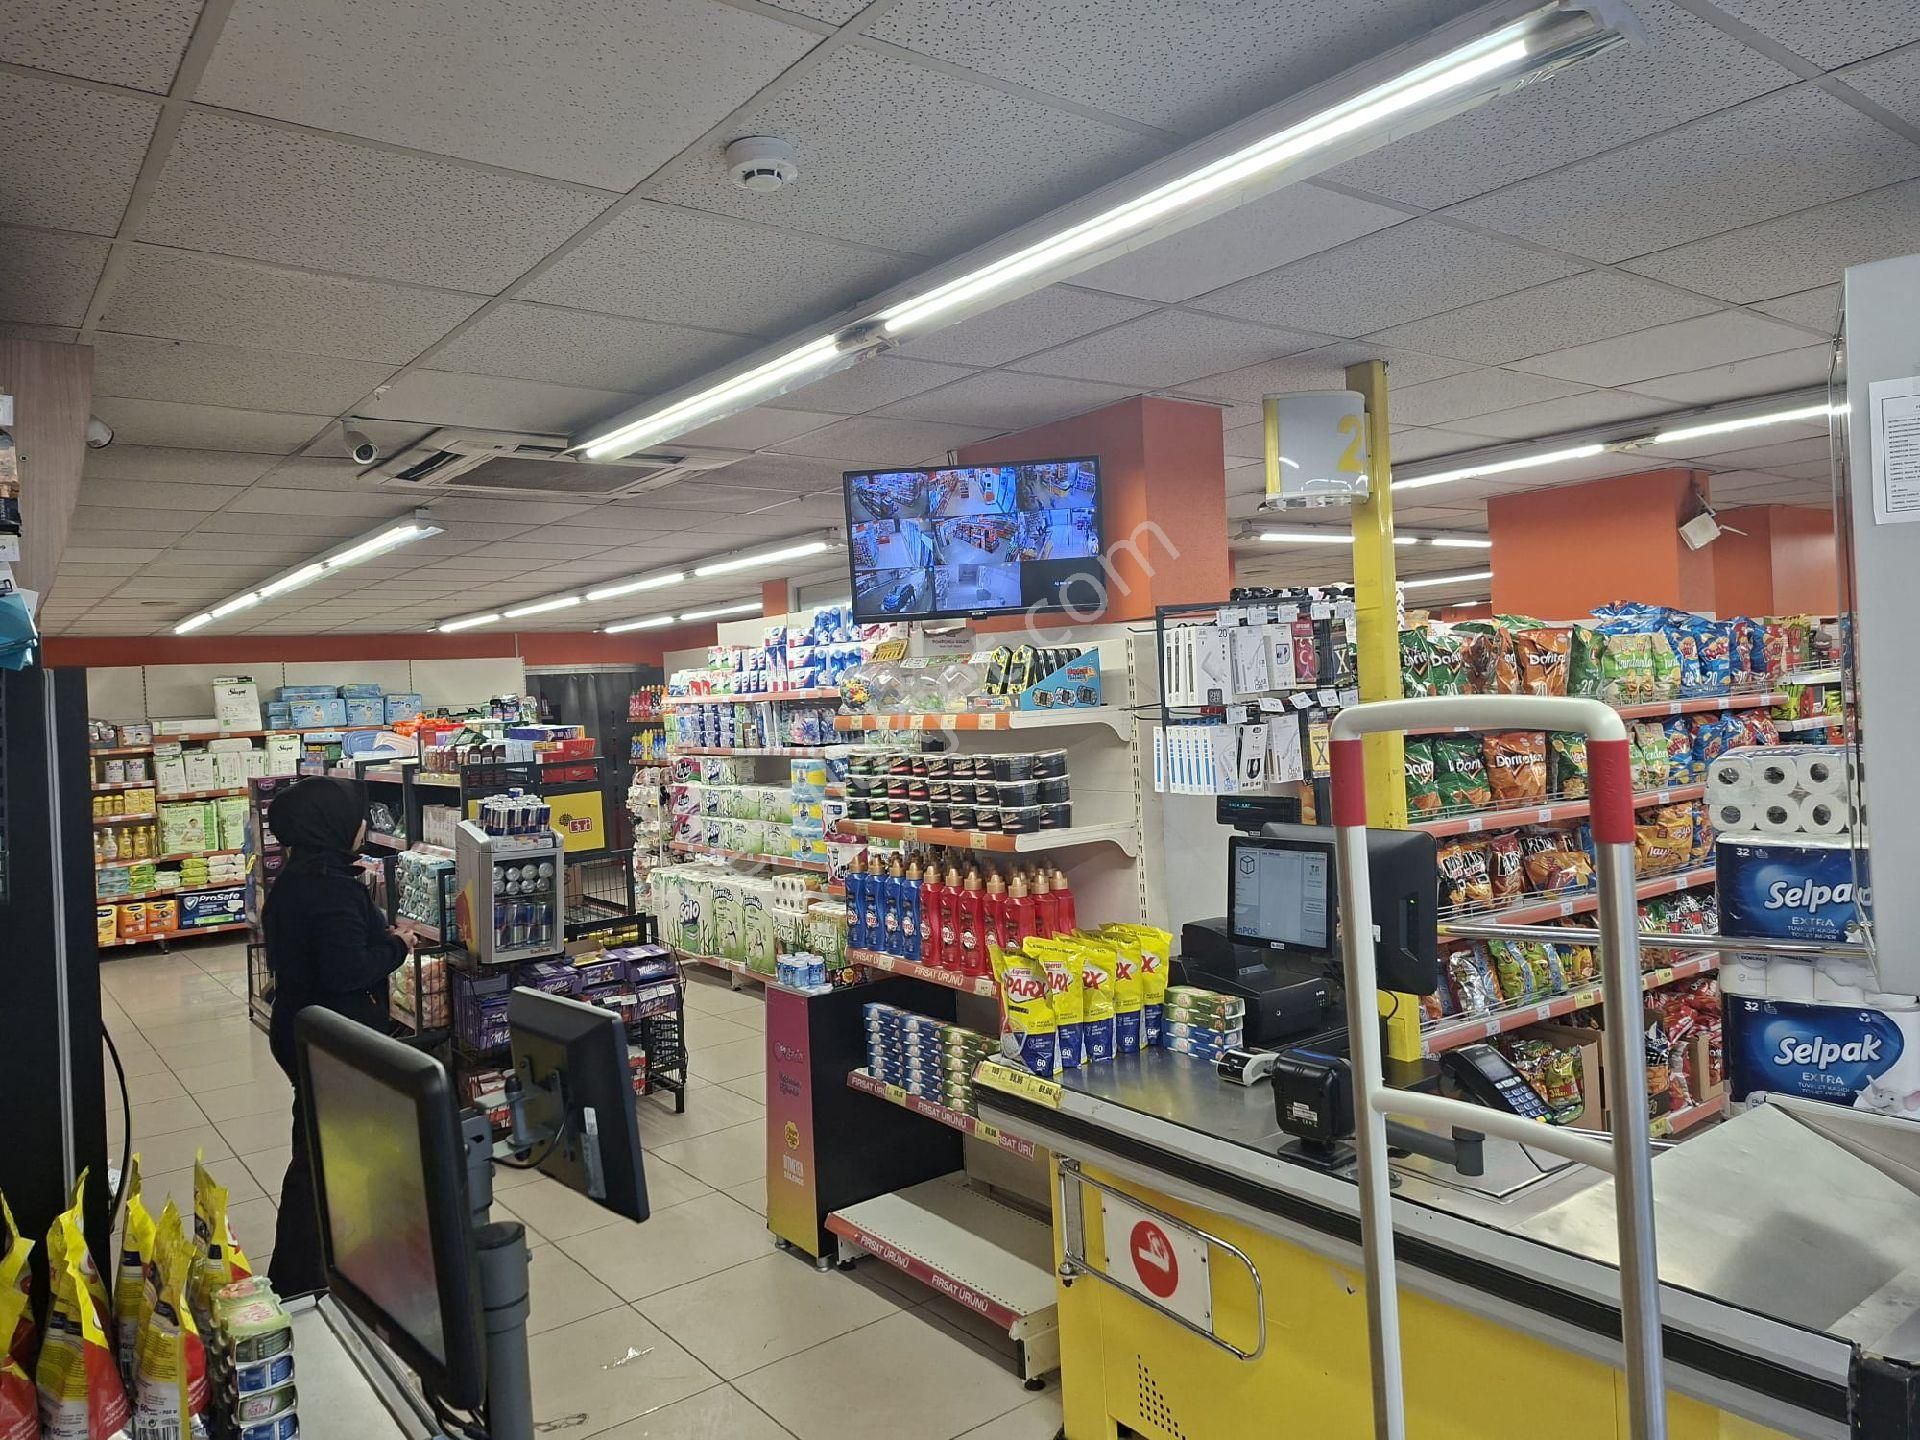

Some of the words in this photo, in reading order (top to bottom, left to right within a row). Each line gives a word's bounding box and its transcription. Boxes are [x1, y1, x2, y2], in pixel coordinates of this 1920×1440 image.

[1336, 415, 1364, 473] 2
[1313, 741, 1330, 766] X
[1736, 847, 1750, 857] 32
[198, 891, 241, 903] ProSafe
[680, 900, 701, 924] Solo
[1791, 916, 1835, 927] EXTRA
[914, 966, 937, 980] FIRSAT
[937, 969, 964, 986] ÜRÜNÜ
[1744, 1001, 1758, 1011] 32
[1093, 1044, 1103, 1053] 60
[1773, 1033, 1882, 1069] Selpak
[1036, 1058, 1046, 1067] 60
[851, 1077, 875, 1093] FIRSAT
[1801, 1071, 1844, 1085] EXTRA
[917, 1102, 941, 1118] FIRSAT
[941, 1110, 967, 1129] ÜRÜNÜ
[860, 1234, 885, 1254] FIRSAT
[883, 1244, 910, 1269] ÜRÜNÜ
[931, 1274, 959, 1296] FIRSAT
[958, 1286, 989, 1313] ÜRÜNÜ
